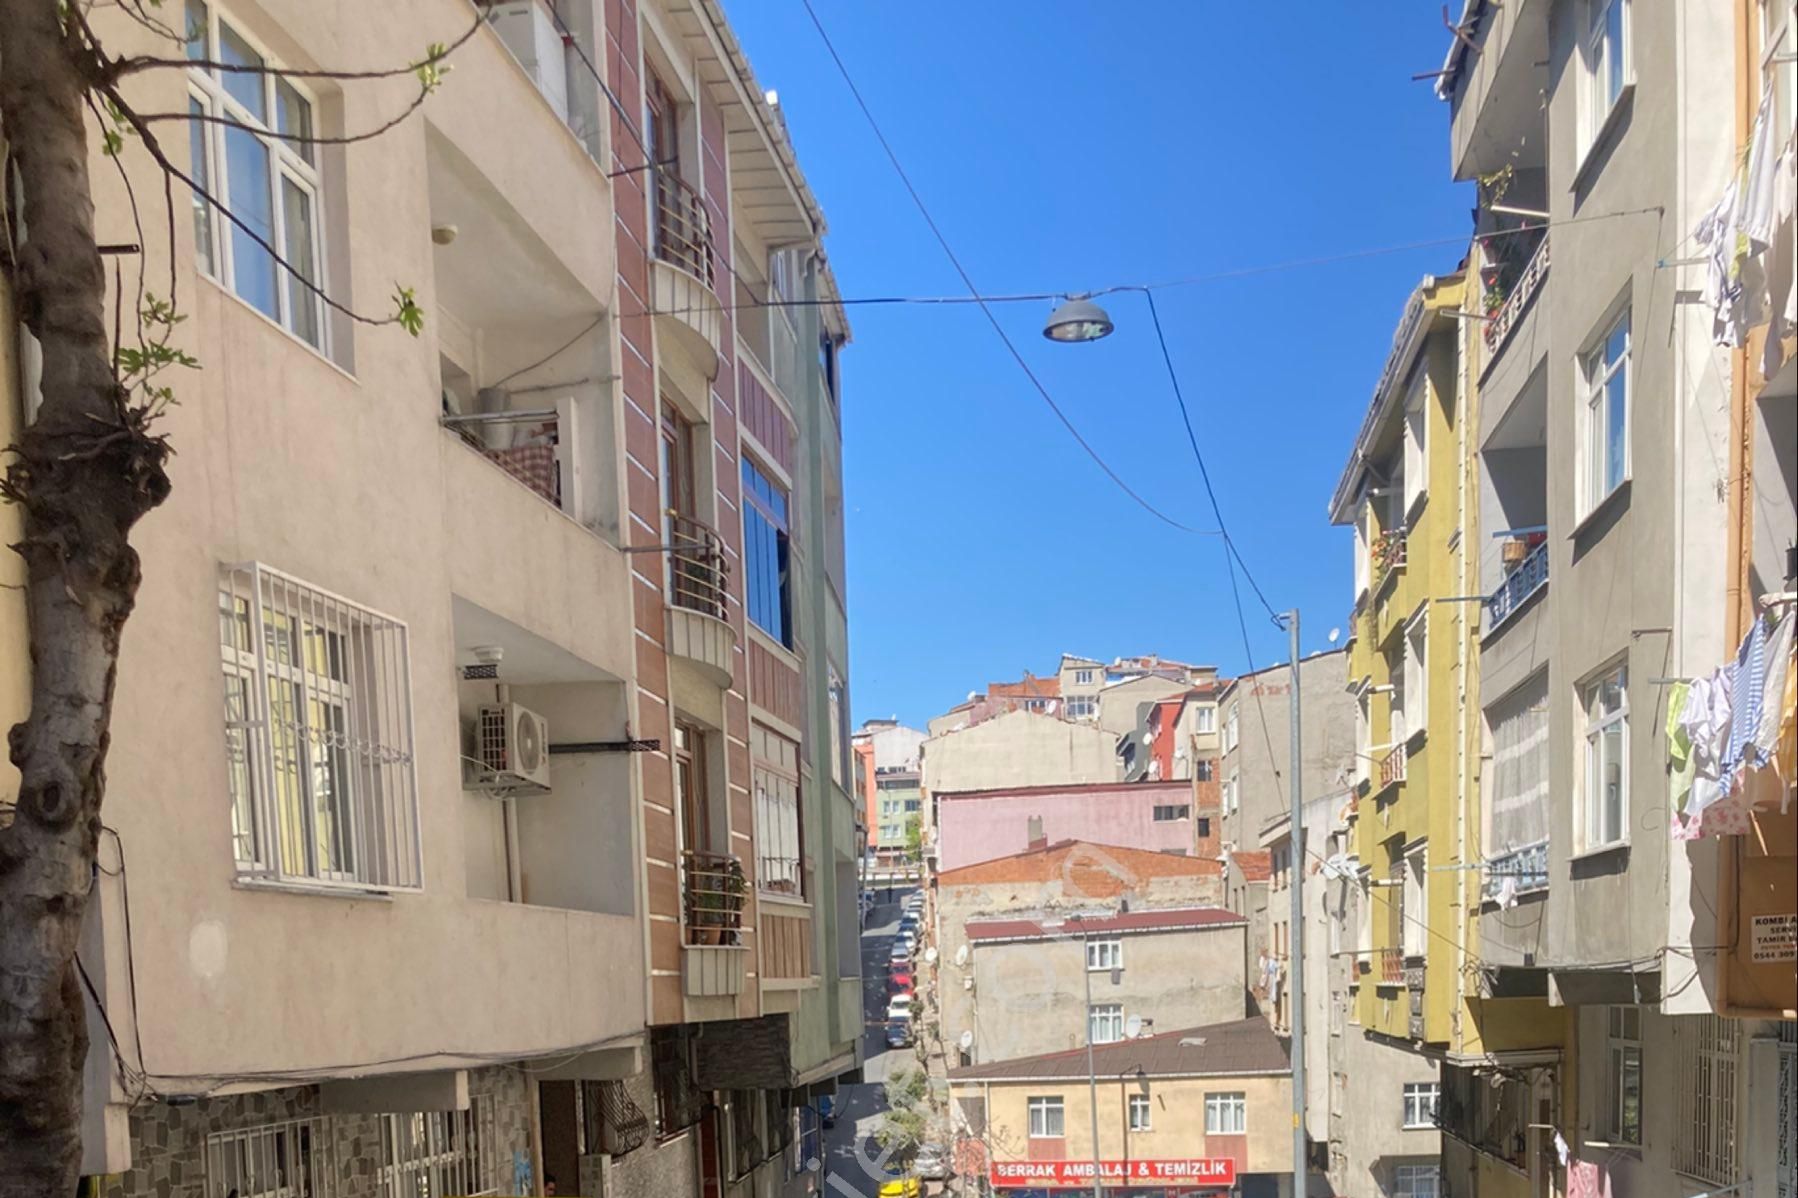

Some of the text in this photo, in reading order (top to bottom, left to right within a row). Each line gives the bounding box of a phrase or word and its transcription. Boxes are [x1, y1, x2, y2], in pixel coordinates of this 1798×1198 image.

[997, 1159, 1227, 1177] BERRAK AMBALAJ & TEMİZLİK
